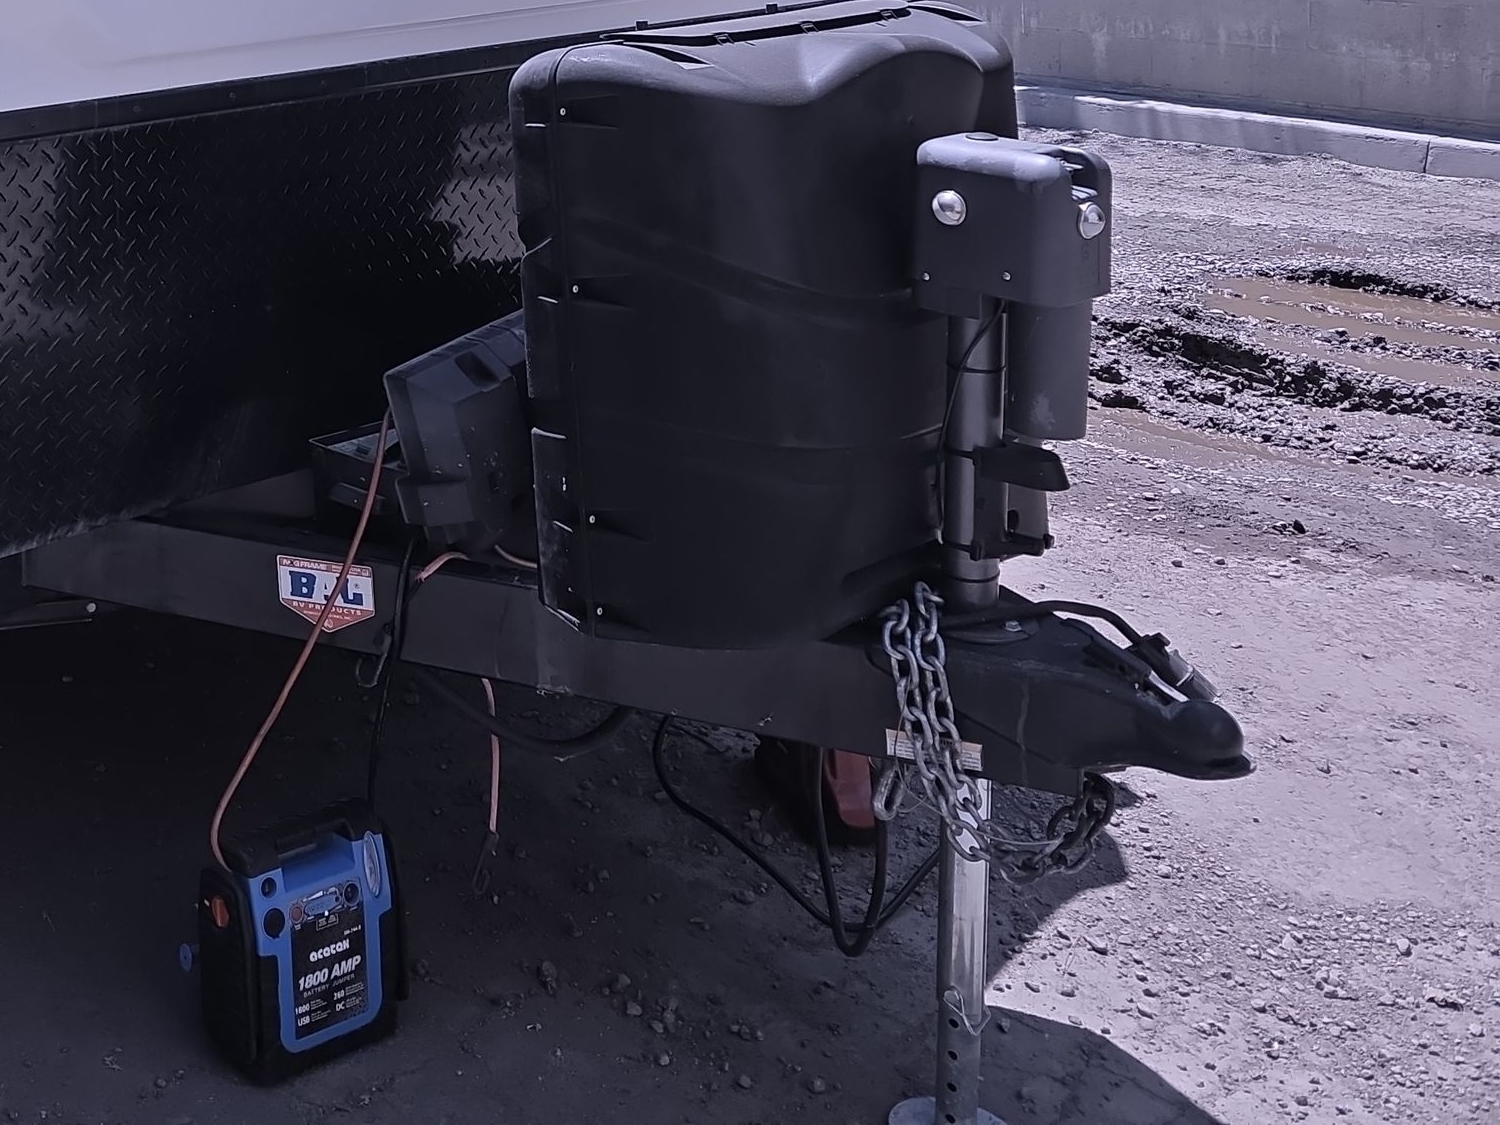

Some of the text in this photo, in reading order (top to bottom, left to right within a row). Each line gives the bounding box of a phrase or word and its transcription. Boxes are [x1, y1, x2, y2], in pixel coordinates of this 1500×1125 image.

[308, 604, 362, 616] PRUCTS
[298, 968, 329, 991] 1800
[330, 955, 361, 980] AMP
[303, 984, 329, 998] BATTERY
[332, 973, 355, 987] JUMPER
